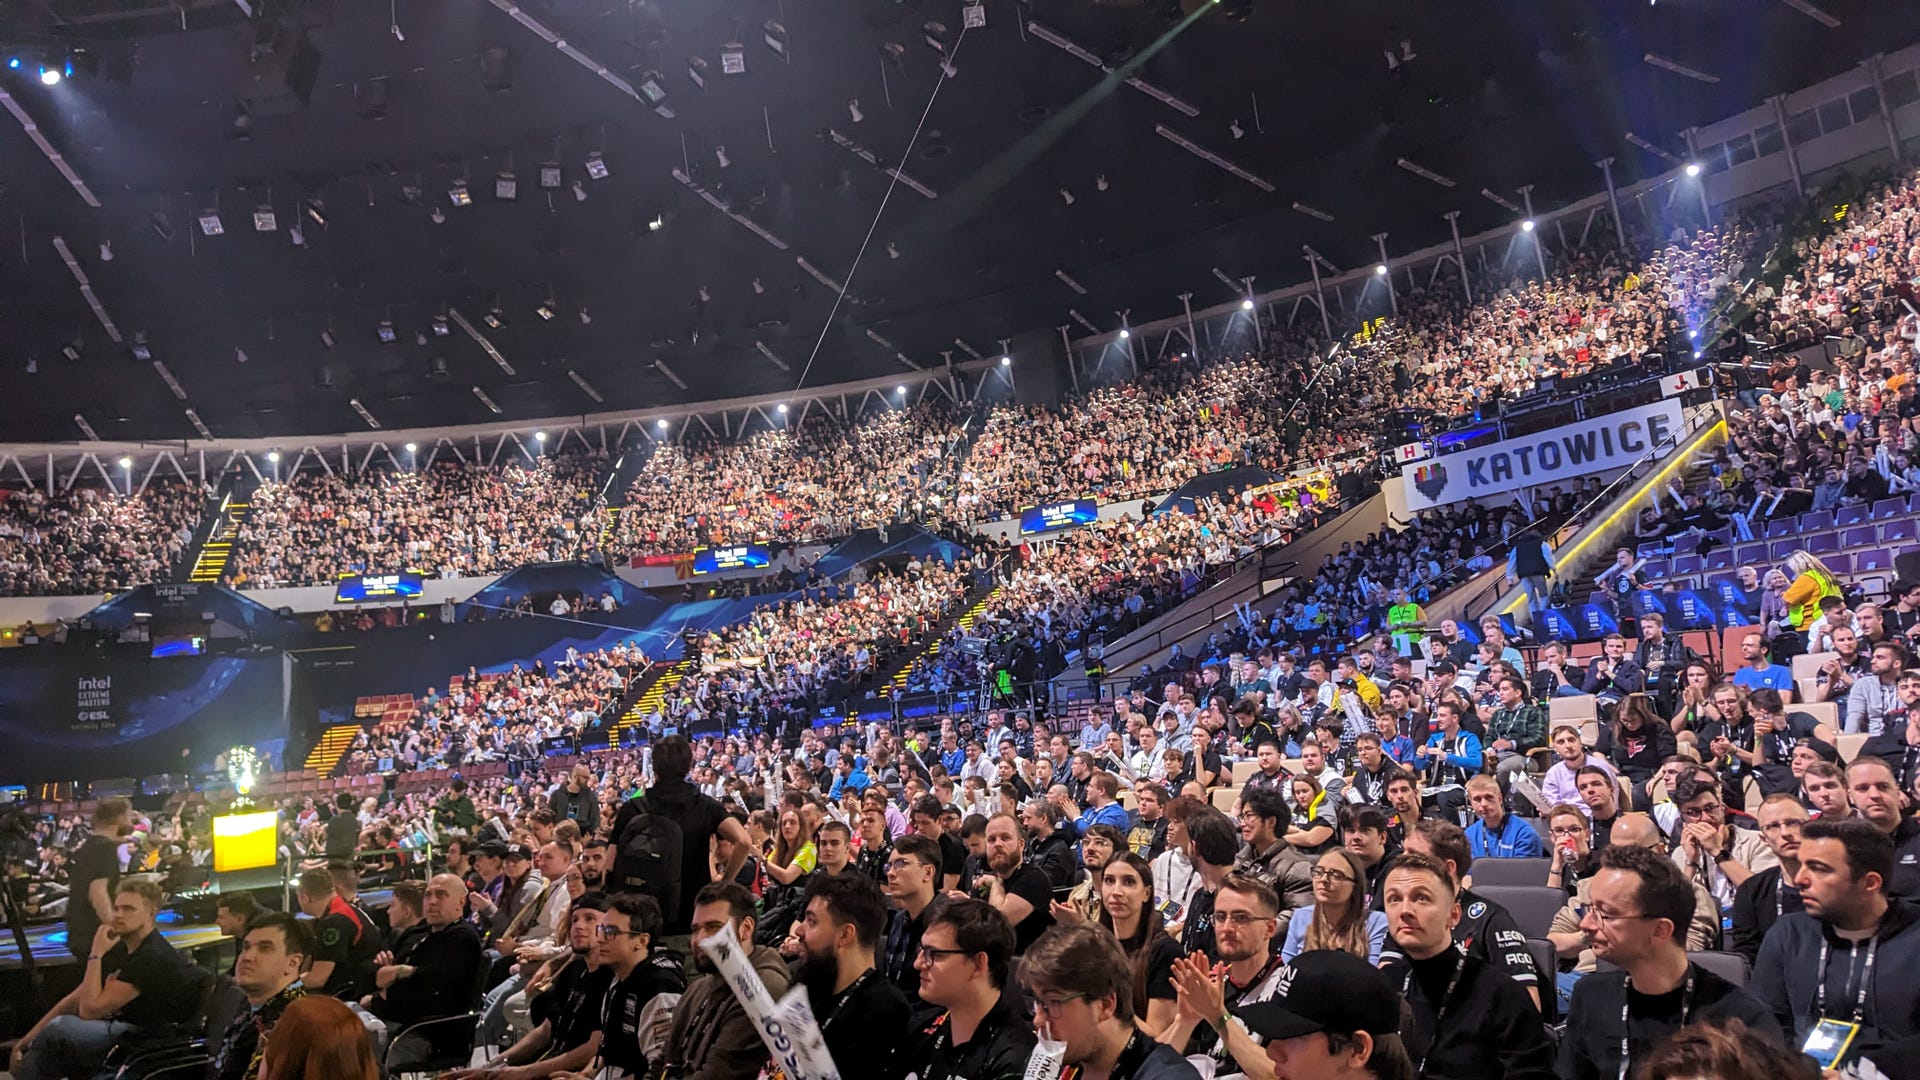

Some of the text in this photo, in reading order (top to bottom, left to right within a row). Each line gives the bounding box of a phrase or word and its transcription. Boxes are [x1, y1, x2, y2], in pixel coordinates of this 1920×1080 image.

[1674, 374, 1685, 390] J
[1403, 445, 1416, 459] H
[1467, 413, 1676, 488] KATOWICE
[155, 586, 178, 597] intel
[79, 675, 111, 690] intel
[1505, 953, 1533, 965] AGO
